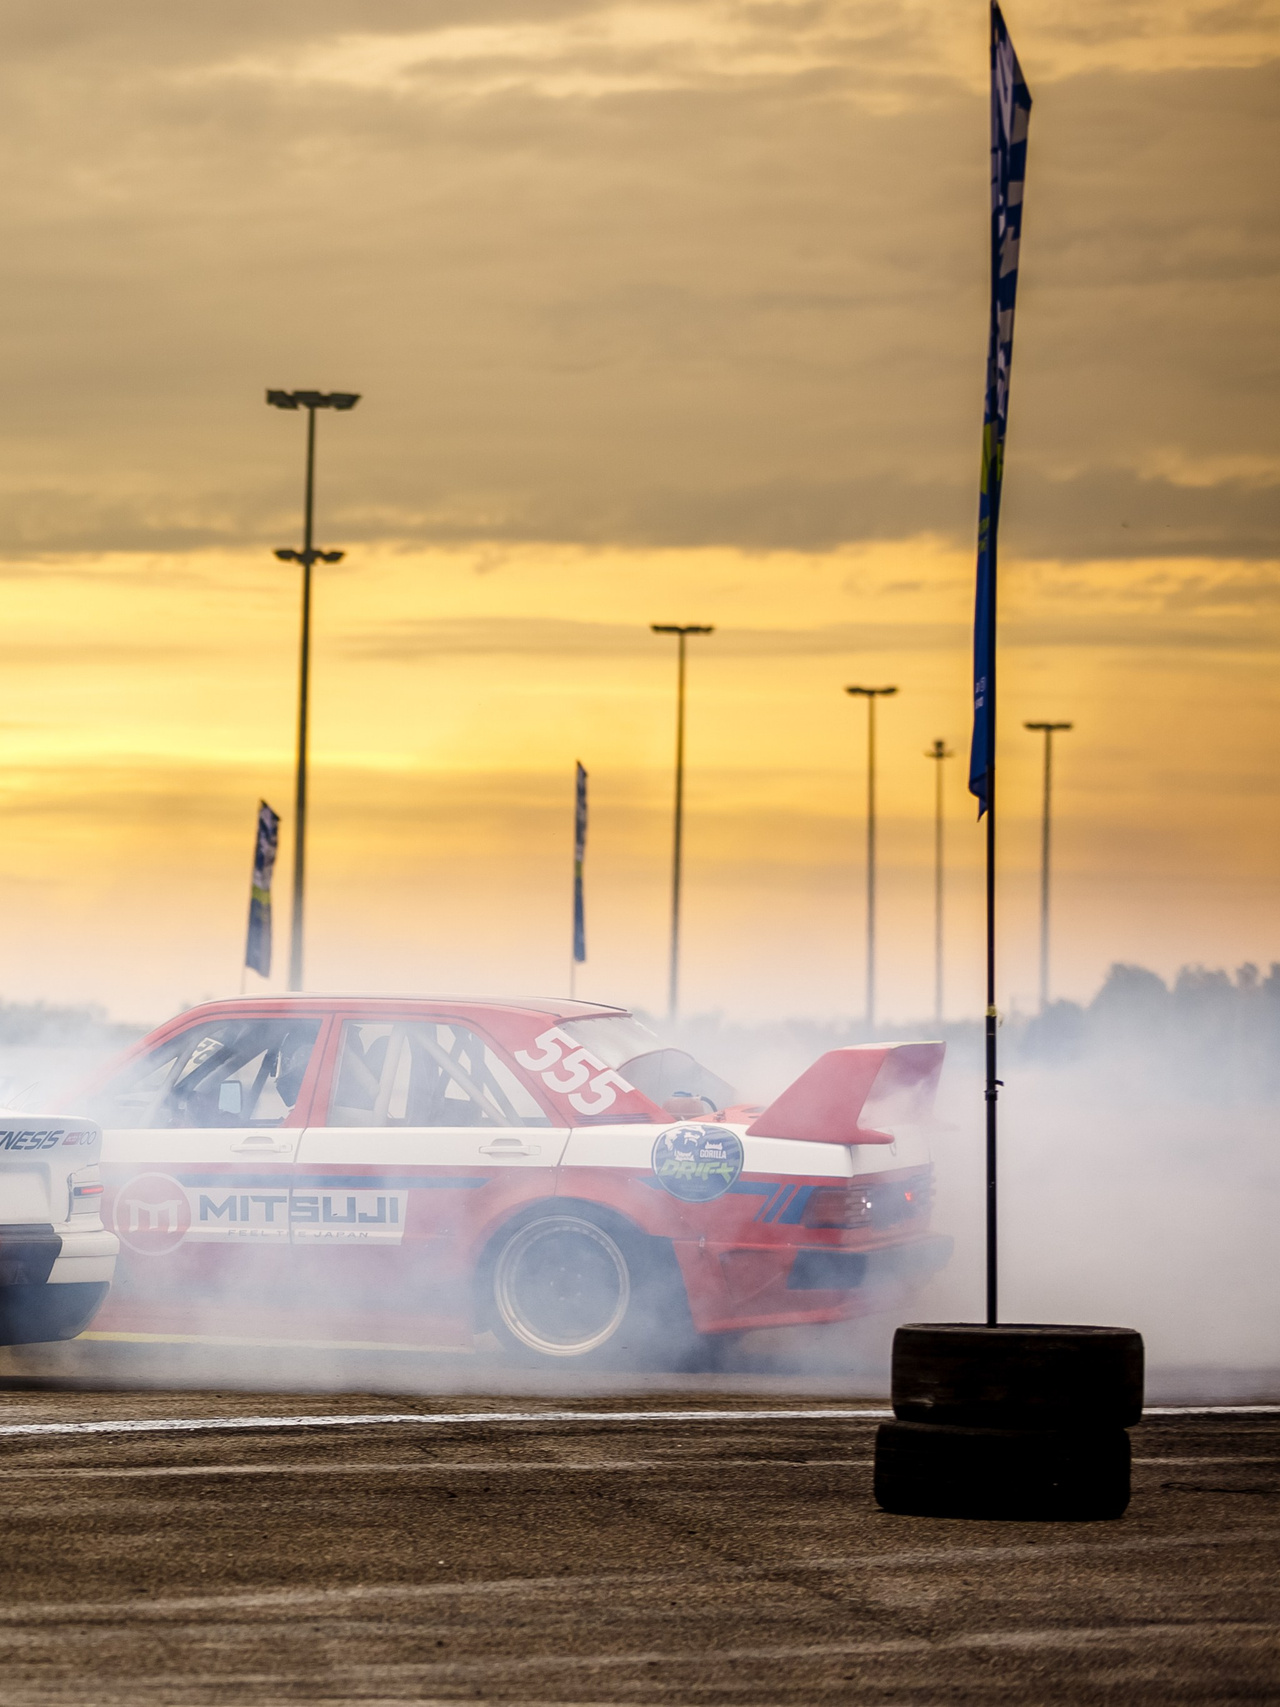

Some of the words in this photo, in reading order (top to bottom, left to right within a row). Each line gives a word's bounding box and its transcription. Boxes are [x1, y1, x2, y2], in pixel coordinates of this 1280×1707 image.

[514, 1026, 636, 1116] 555
[699, 1149, 727, 1160] GORILLA
[660, 1159, 735, 1184] DRIFT
[199, 1194, 399, 1224] MITSUJI
[227, 1229, 269, 1238] FEEL
[313, 1231, 369, 1239] JAPAN
